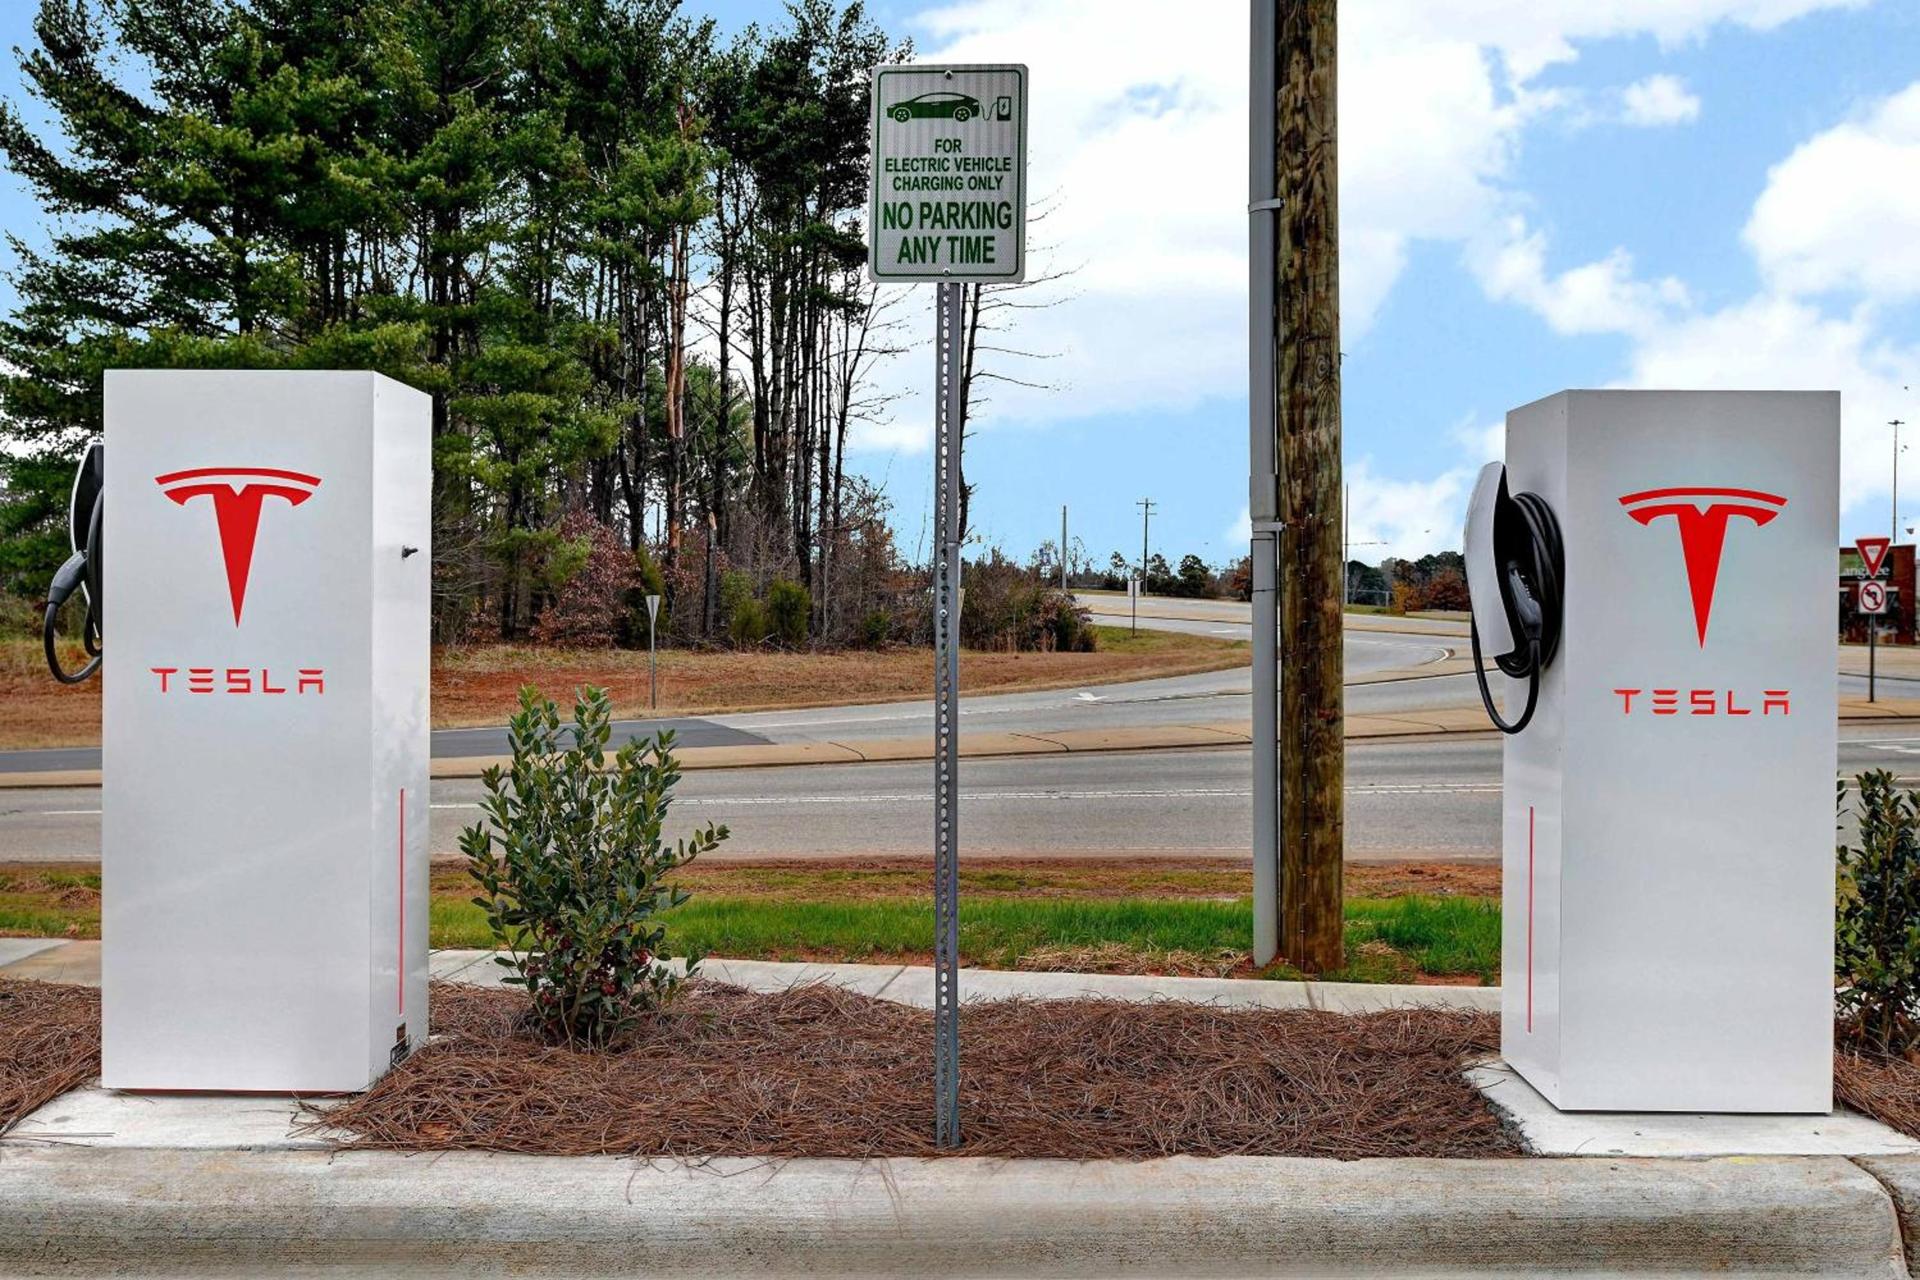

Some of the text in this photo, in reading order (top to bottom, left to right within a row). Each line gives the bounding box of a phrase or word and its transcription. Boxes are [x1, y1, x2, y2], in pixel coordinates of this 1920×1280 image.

[935, 139, 962, 153] FOR
[885, 157, 1012, 172] ELECTRIC VEHICLE
[893, 175, 1003, 191] CHARGING ONLY
[883, 201, 1012, 230] NO PARKING
[897, 236, 996, 264] ANY TIME
[151, 668, 324, 694] TESLA
[1614, 689, 1790, 715] TESLA
